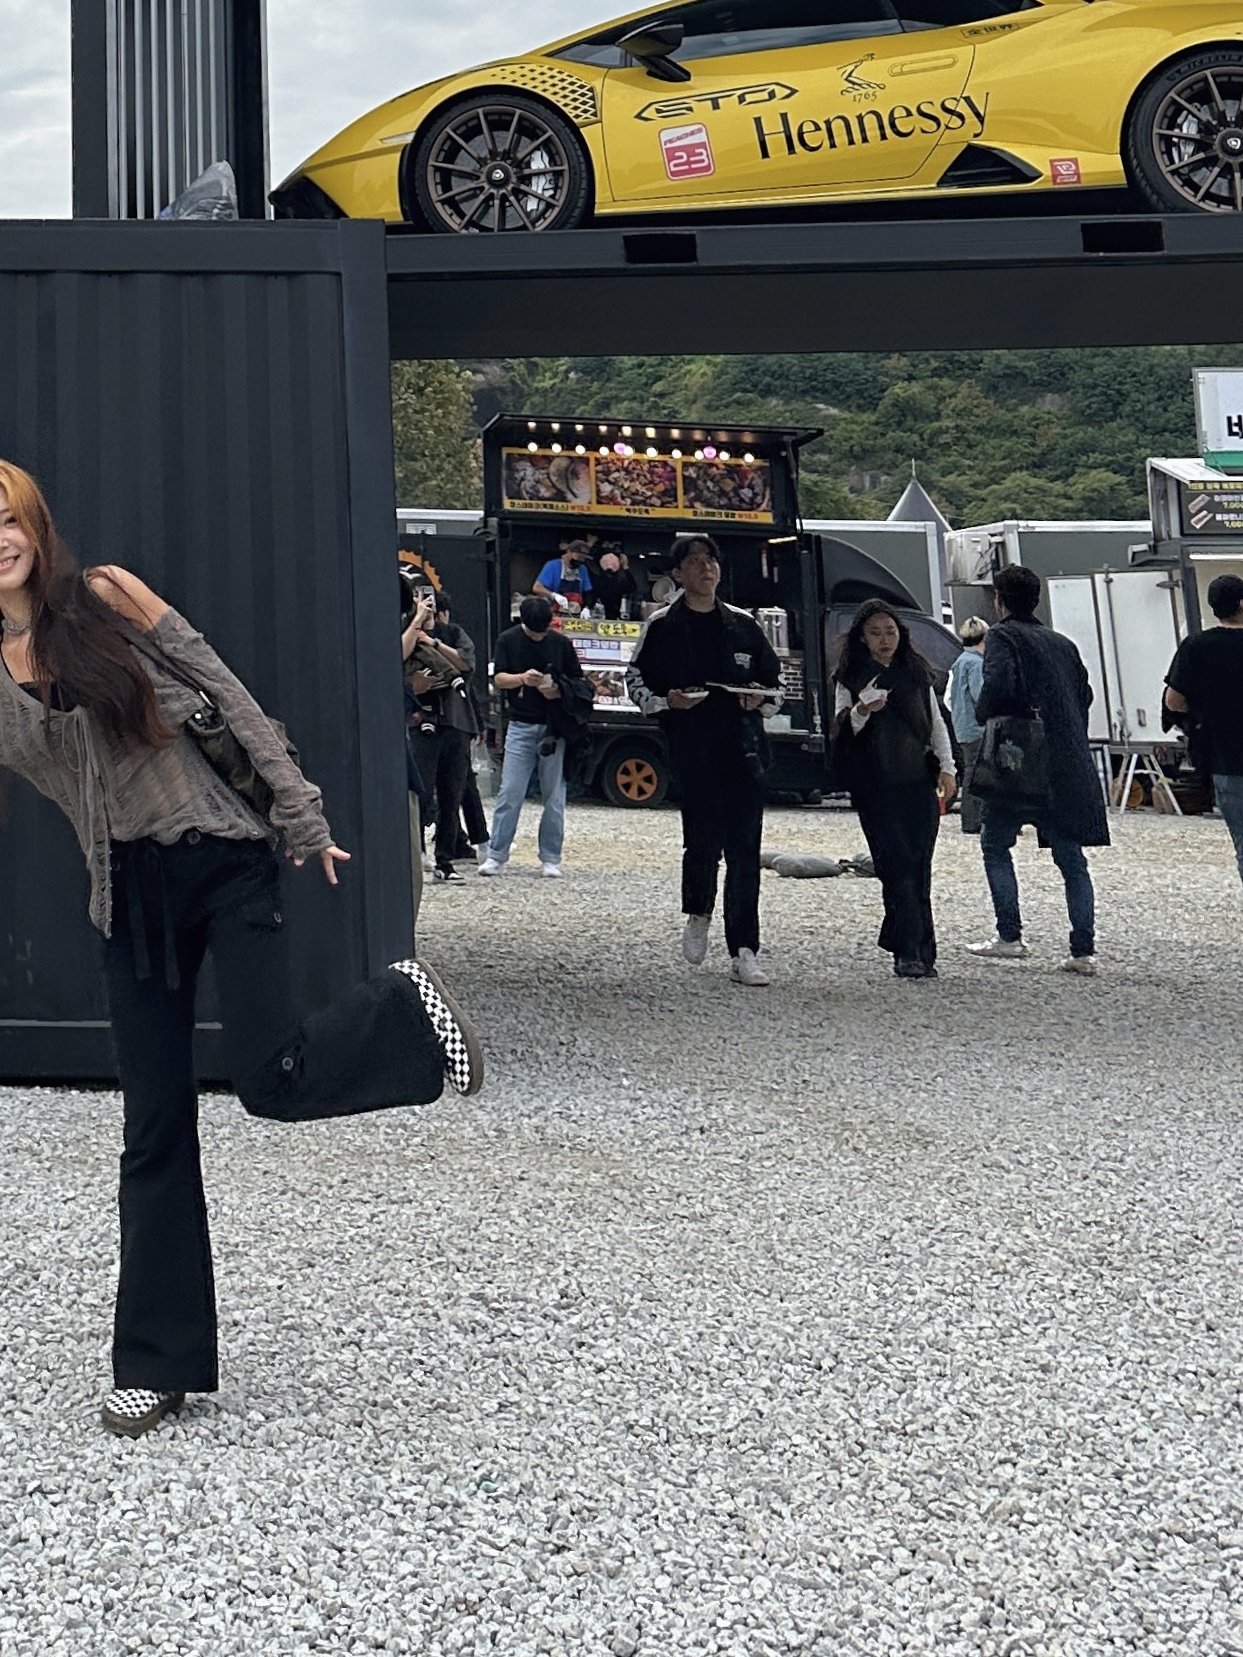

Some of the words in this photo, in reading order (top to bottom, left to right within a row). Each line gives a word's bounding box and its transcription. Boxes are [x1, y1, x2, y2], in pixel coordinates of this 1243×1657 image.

[853, 92, 877, 103] 1765
[753, 93, 990, 160] Hennessy
[669, 148, 709, 172] 23
